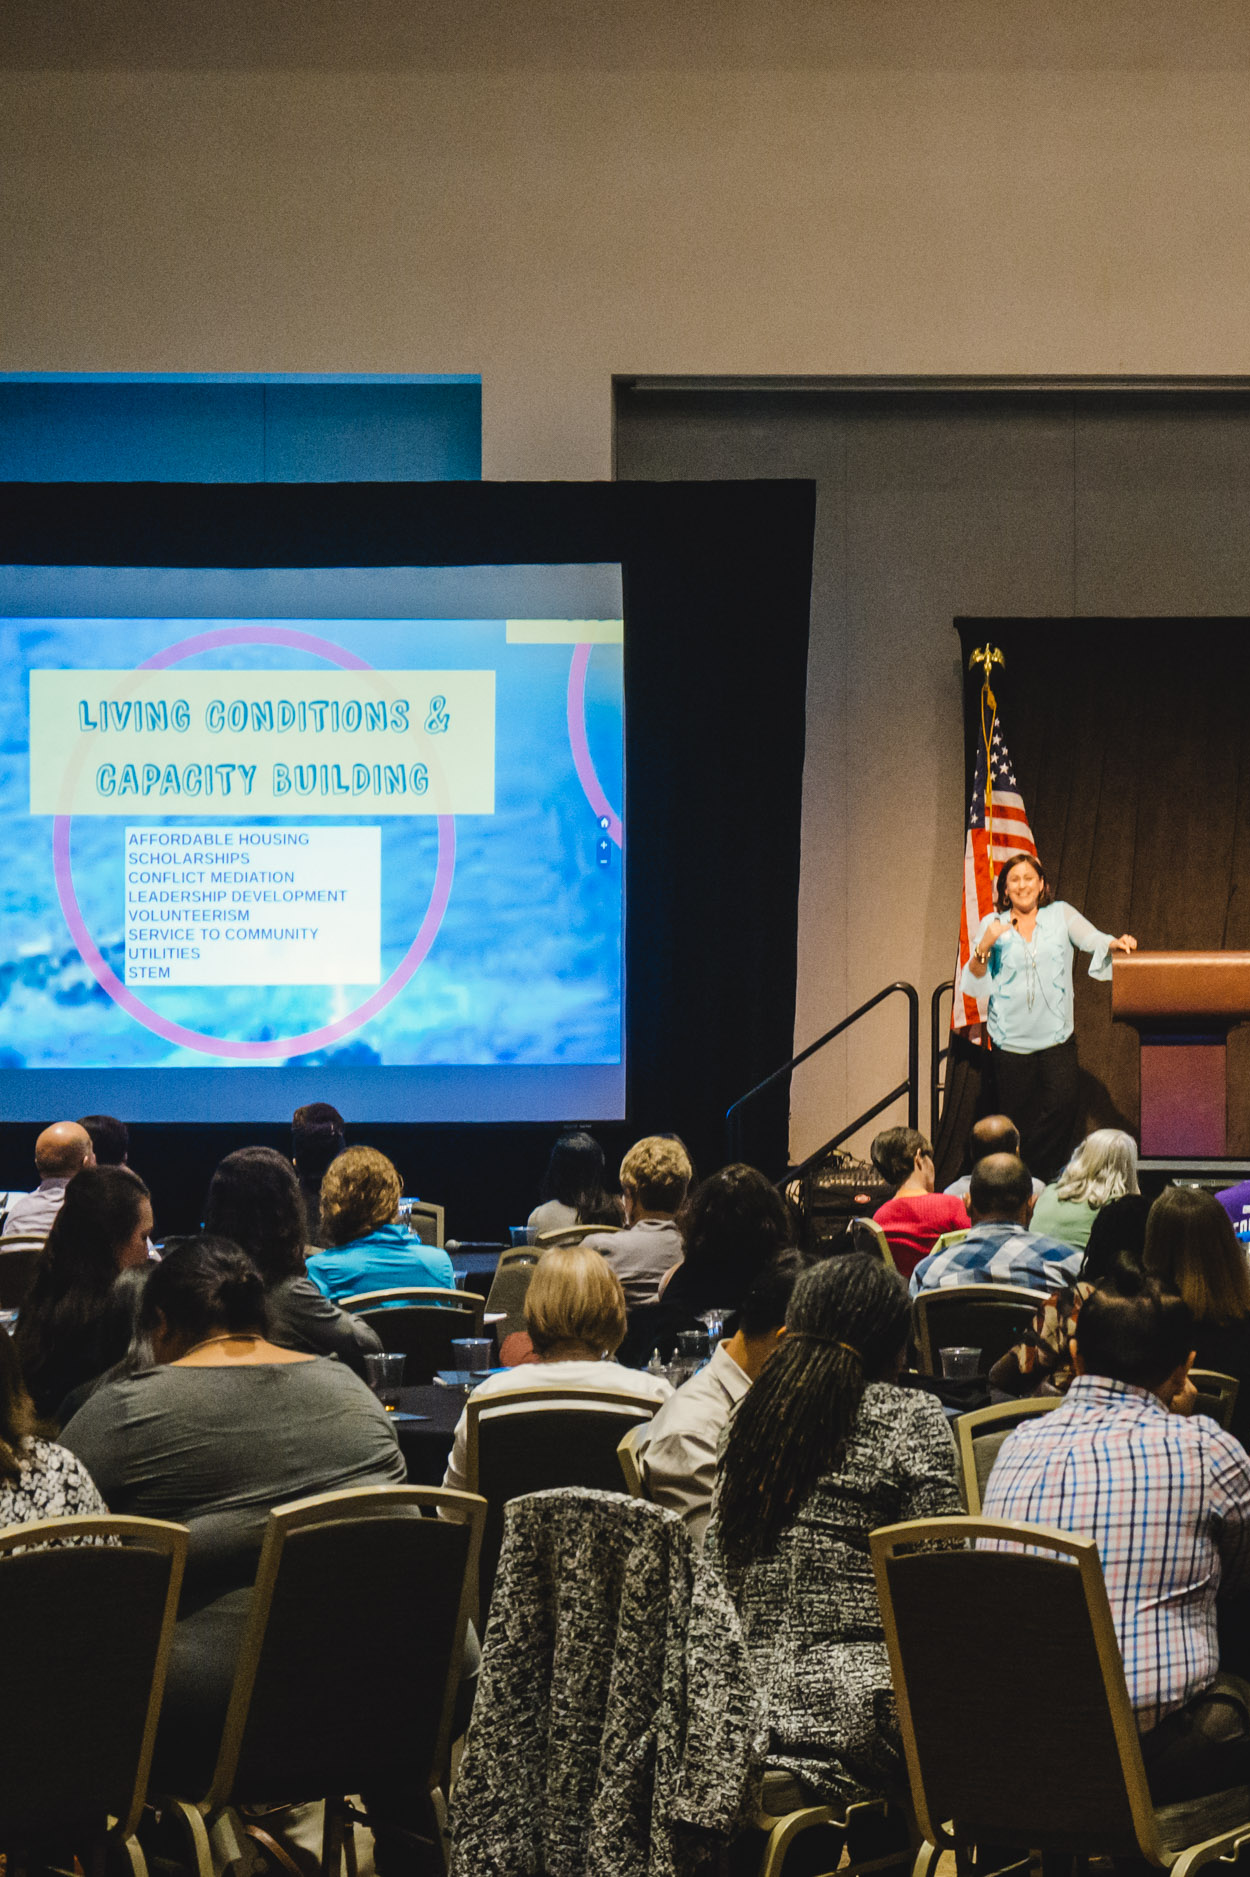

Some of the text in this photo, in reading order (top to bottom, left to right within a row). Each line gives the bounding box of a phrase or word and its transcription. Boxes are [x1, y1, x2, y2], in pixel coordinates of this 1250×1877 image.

[79, 695, 451, 734] LIVING CONDITIONS &
[96, 763, 430, 797] CAPACITY BUILDING
[128, 833, 310, 846] AFFORDABLE HOUSING
[128, 852, 251, 865] SCHOLARSHIPS
[128, 871, 295, 884] CONFLICT MEDIATION
[128, 889, 348, 903] LEADERSHIP DEVELOPMENT
[128, 909, 250, 922] VOLUNTEERISM
[128, 927, 319, 941] SERVICE TO COMMUNITY
[128, 947, 201, 960] UTILITIES
[128, 966, 171, 979] STEM
